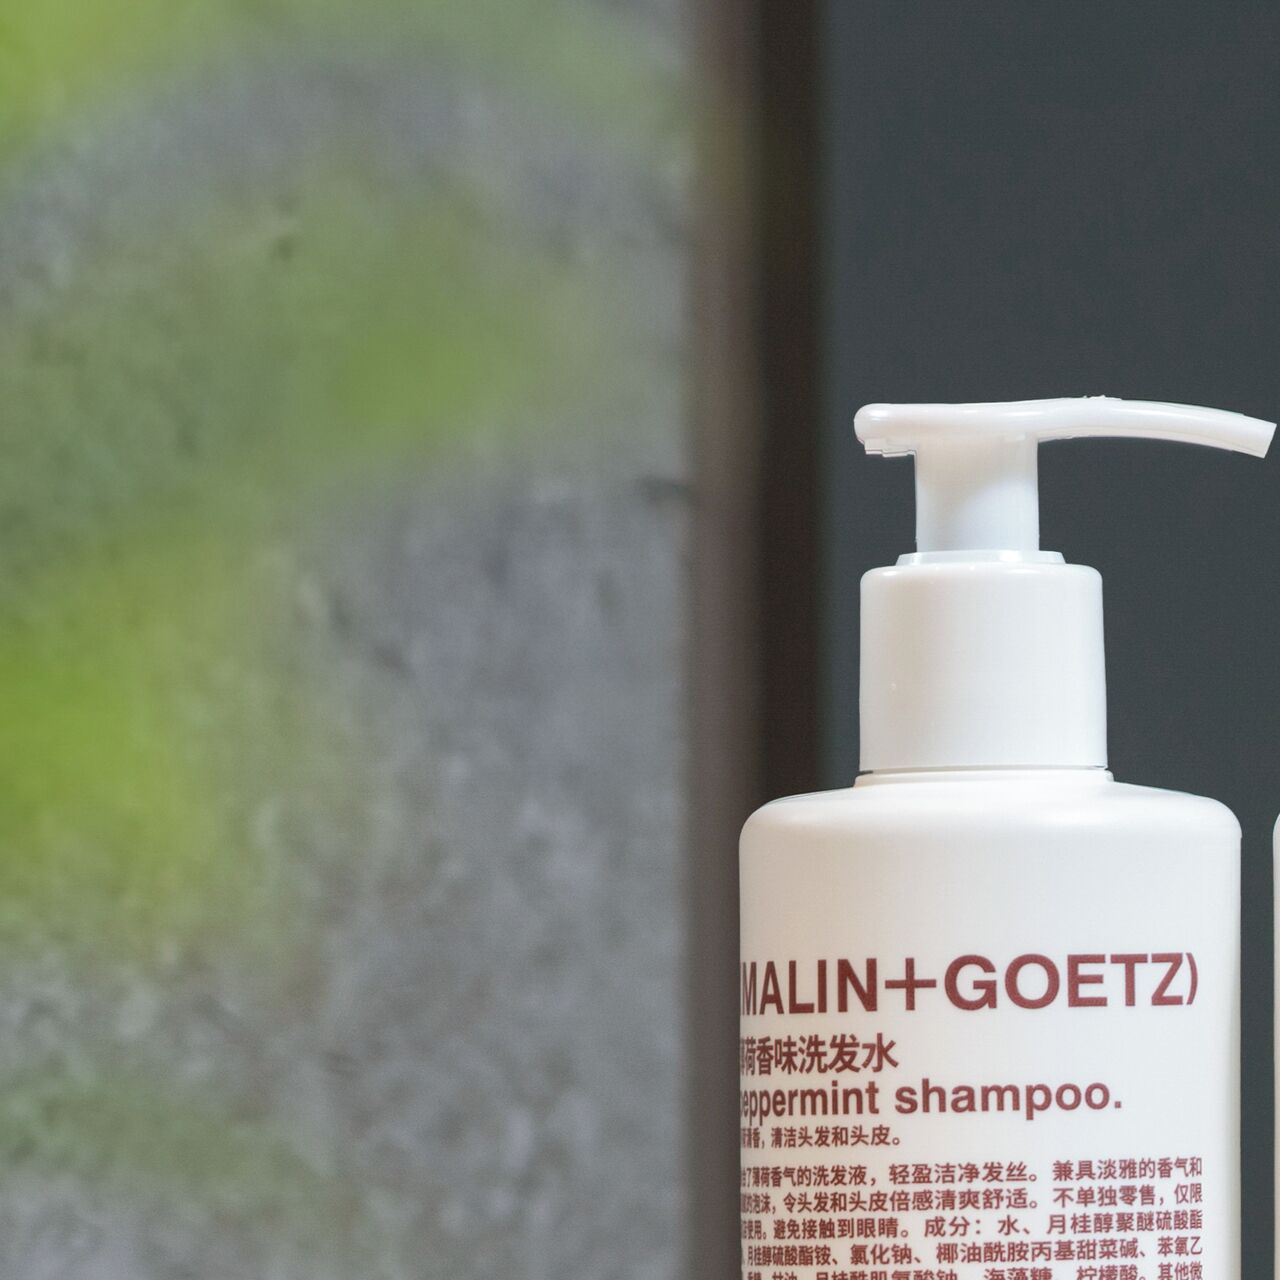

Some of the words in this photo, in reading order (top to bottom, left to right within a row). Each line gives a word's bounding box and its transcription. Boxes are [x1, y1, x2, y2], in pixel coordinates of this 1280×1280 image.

[741, 951, 1199, 1016] MALIN+GOETZ)
[742, 1079, 880, 1128] eppermint
[894, 1077, 1122, 1121] shampoo.
